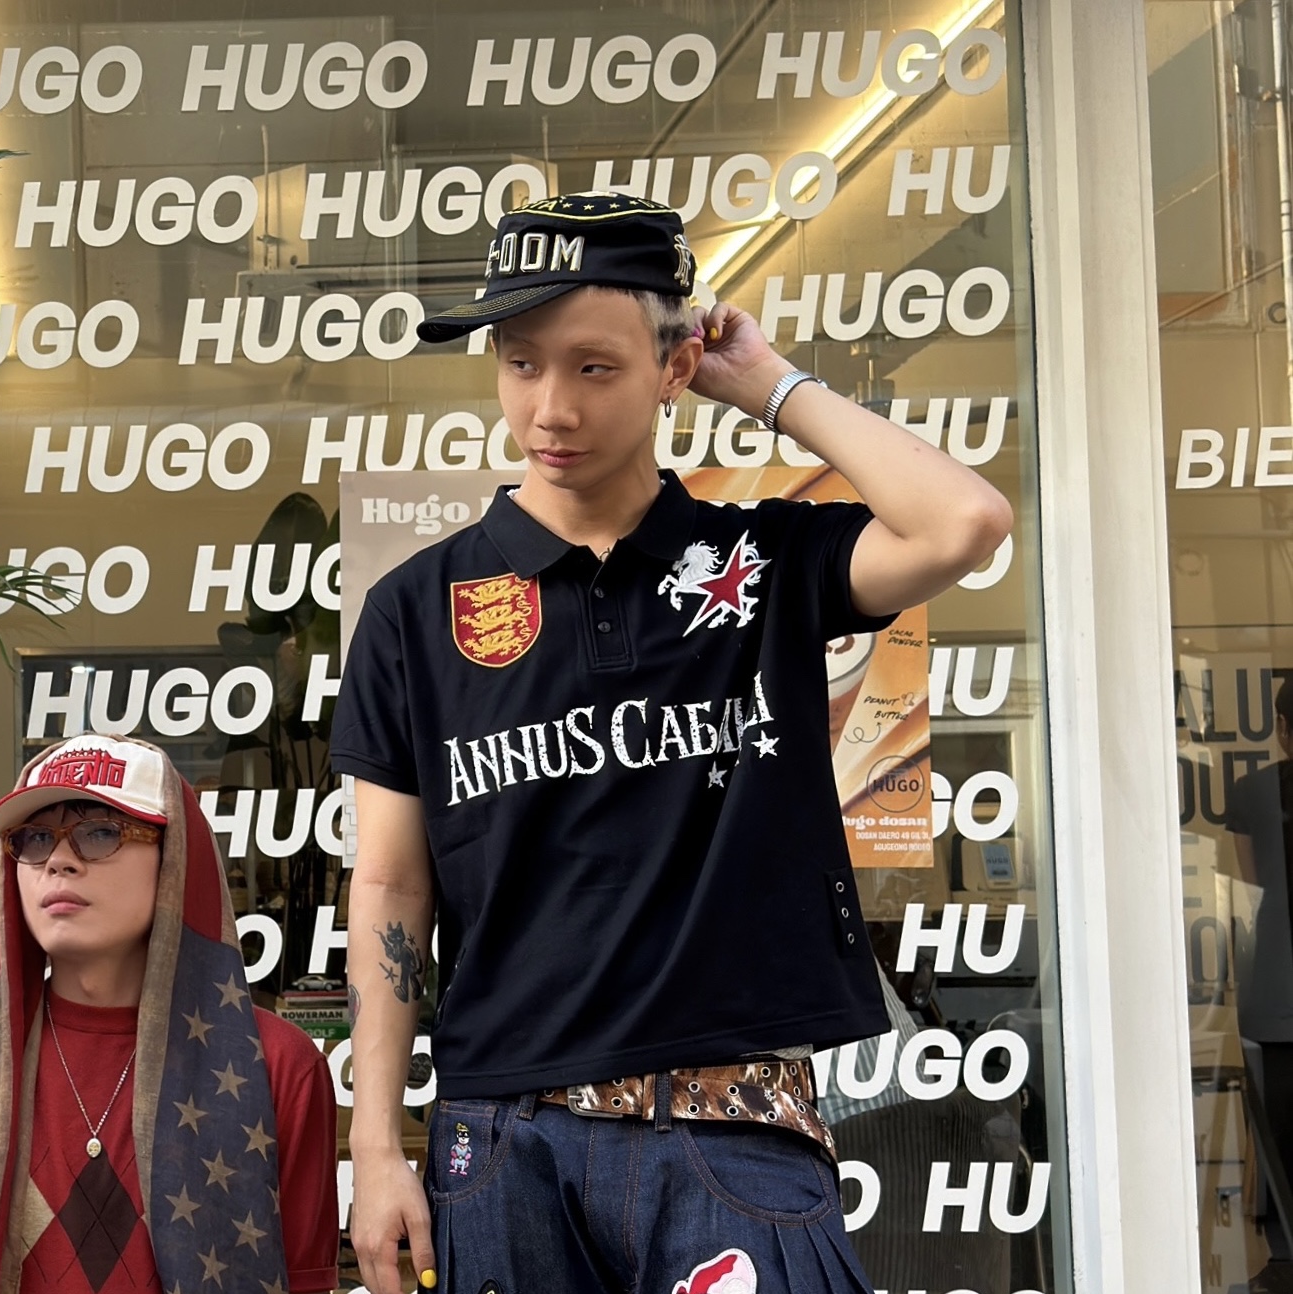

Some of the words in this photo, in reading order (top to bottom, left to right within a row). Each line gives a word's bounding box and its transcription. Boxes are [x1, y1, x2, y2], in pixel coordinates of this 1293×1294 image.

[182, 40, 427, 111] HUGO
[467, 33, 716, 107] HUGO
[757, 28, 1006, 99] HUGO
[15, 175, 257, 248] HUGO
[300, 163, 548, 239] HUGO
[887, 144, 1009, 216] HU
[178, 291, 428, 365] HUGO
[760, 267, 1009, 342] HUGO
[25, 422, 269, 493] HUGO
[361, 494, 470, 535] Hugo
[887, 638, 923, 648] POWDER
[27, 666, 272, 738] HUGO
[864, 696, 900, 706] PEANUT
[874, 710, 909, 721] BUTTER
[872, 780, 919, 793] HUGO
[897, 904, 1025, 973] HU
[281, 1011, 343, 1019] BOWERMAN
[307, 1028, 336, 1037] GOLF
[922, 1161, 1050, 1231] HU
